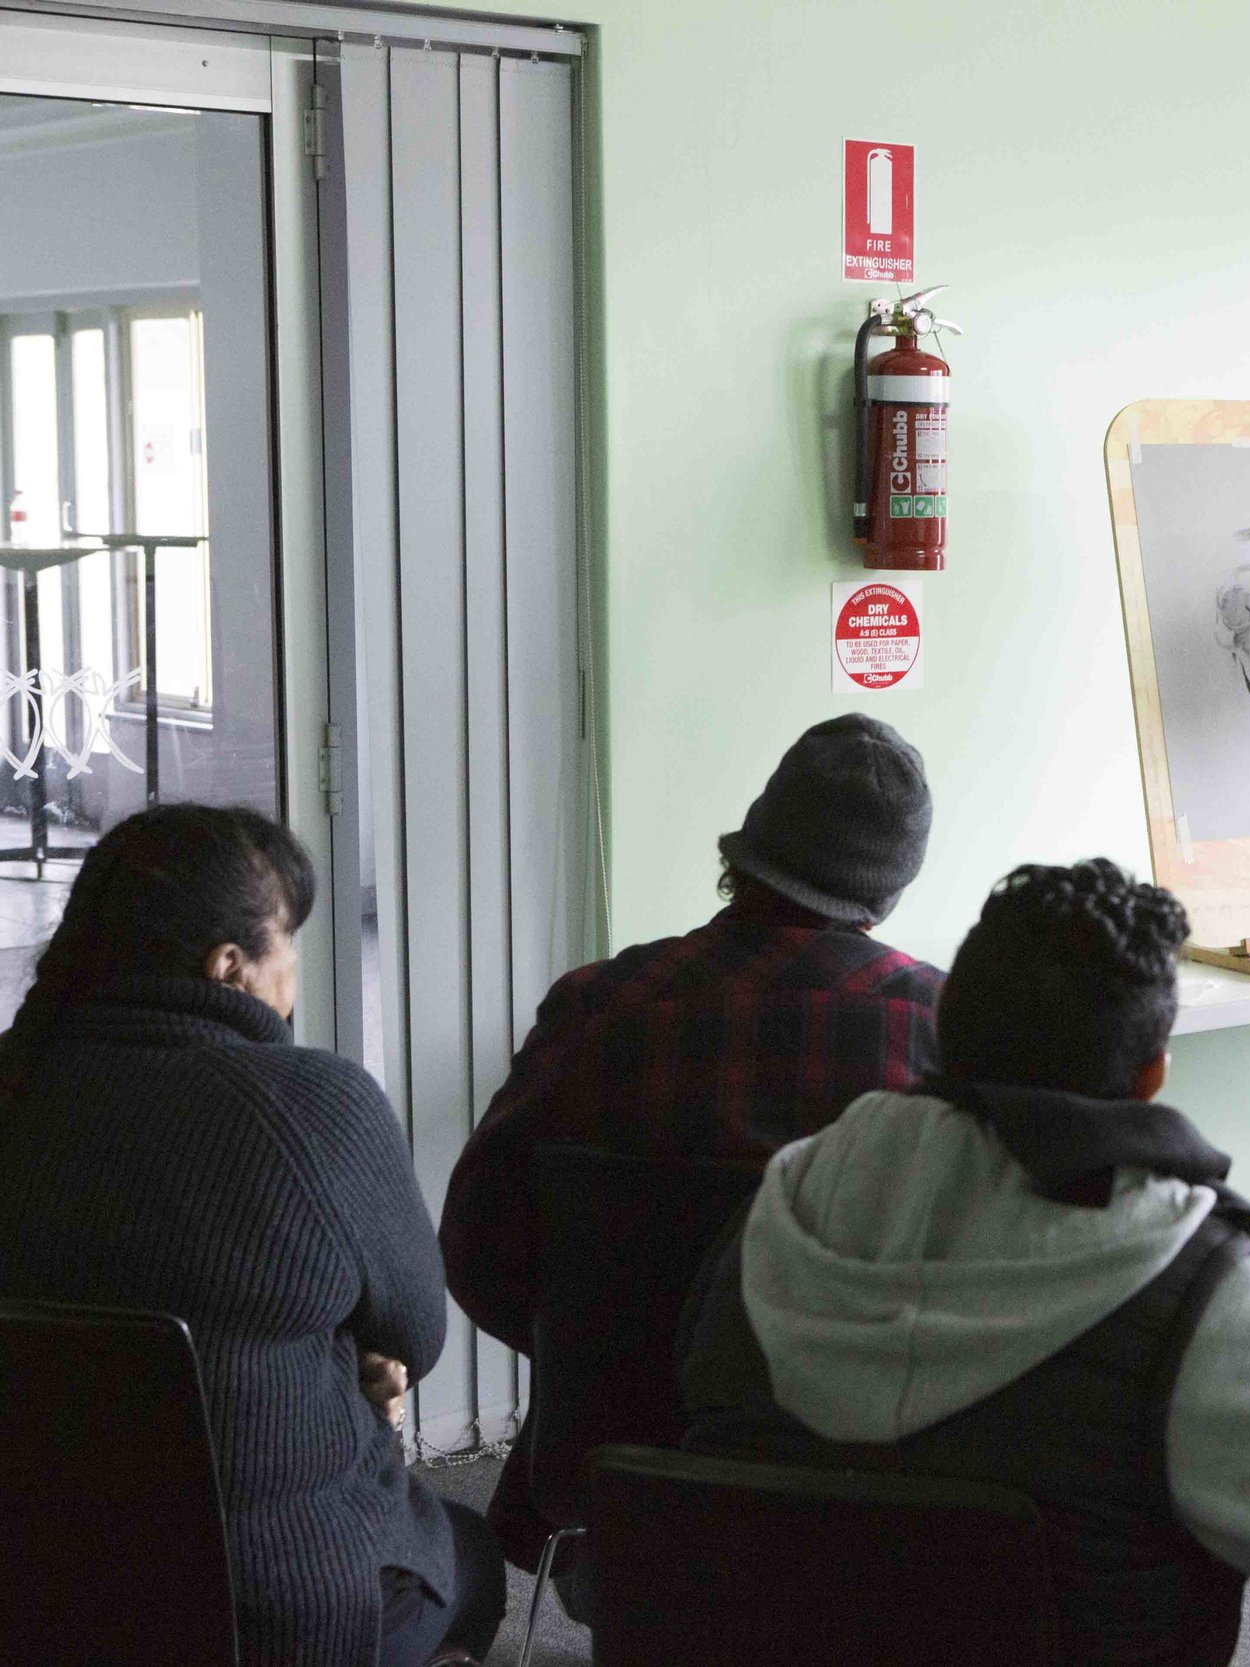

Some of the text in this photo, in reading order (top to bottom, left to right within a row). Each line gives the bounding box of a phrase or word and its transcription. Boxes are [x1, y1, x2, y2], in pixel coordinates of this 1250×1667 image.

[866, 239, 892, 252] FIRE
[846, 255, 912, 270] EXTINGUISHER
[892, 410, 908, 472] Chubb
[852, 592, 865, 605] THIS
[868, 604, 889, 615] DRY
[848, 615, 908, 627] CHEMICALS
[879, 628, 897, 636] CLASS
[863, 640, 878, 648] USED
[879, 639, 889, 647] FOR
[846, 654, 910, 664] LIQUID AND ELECTRICAL
